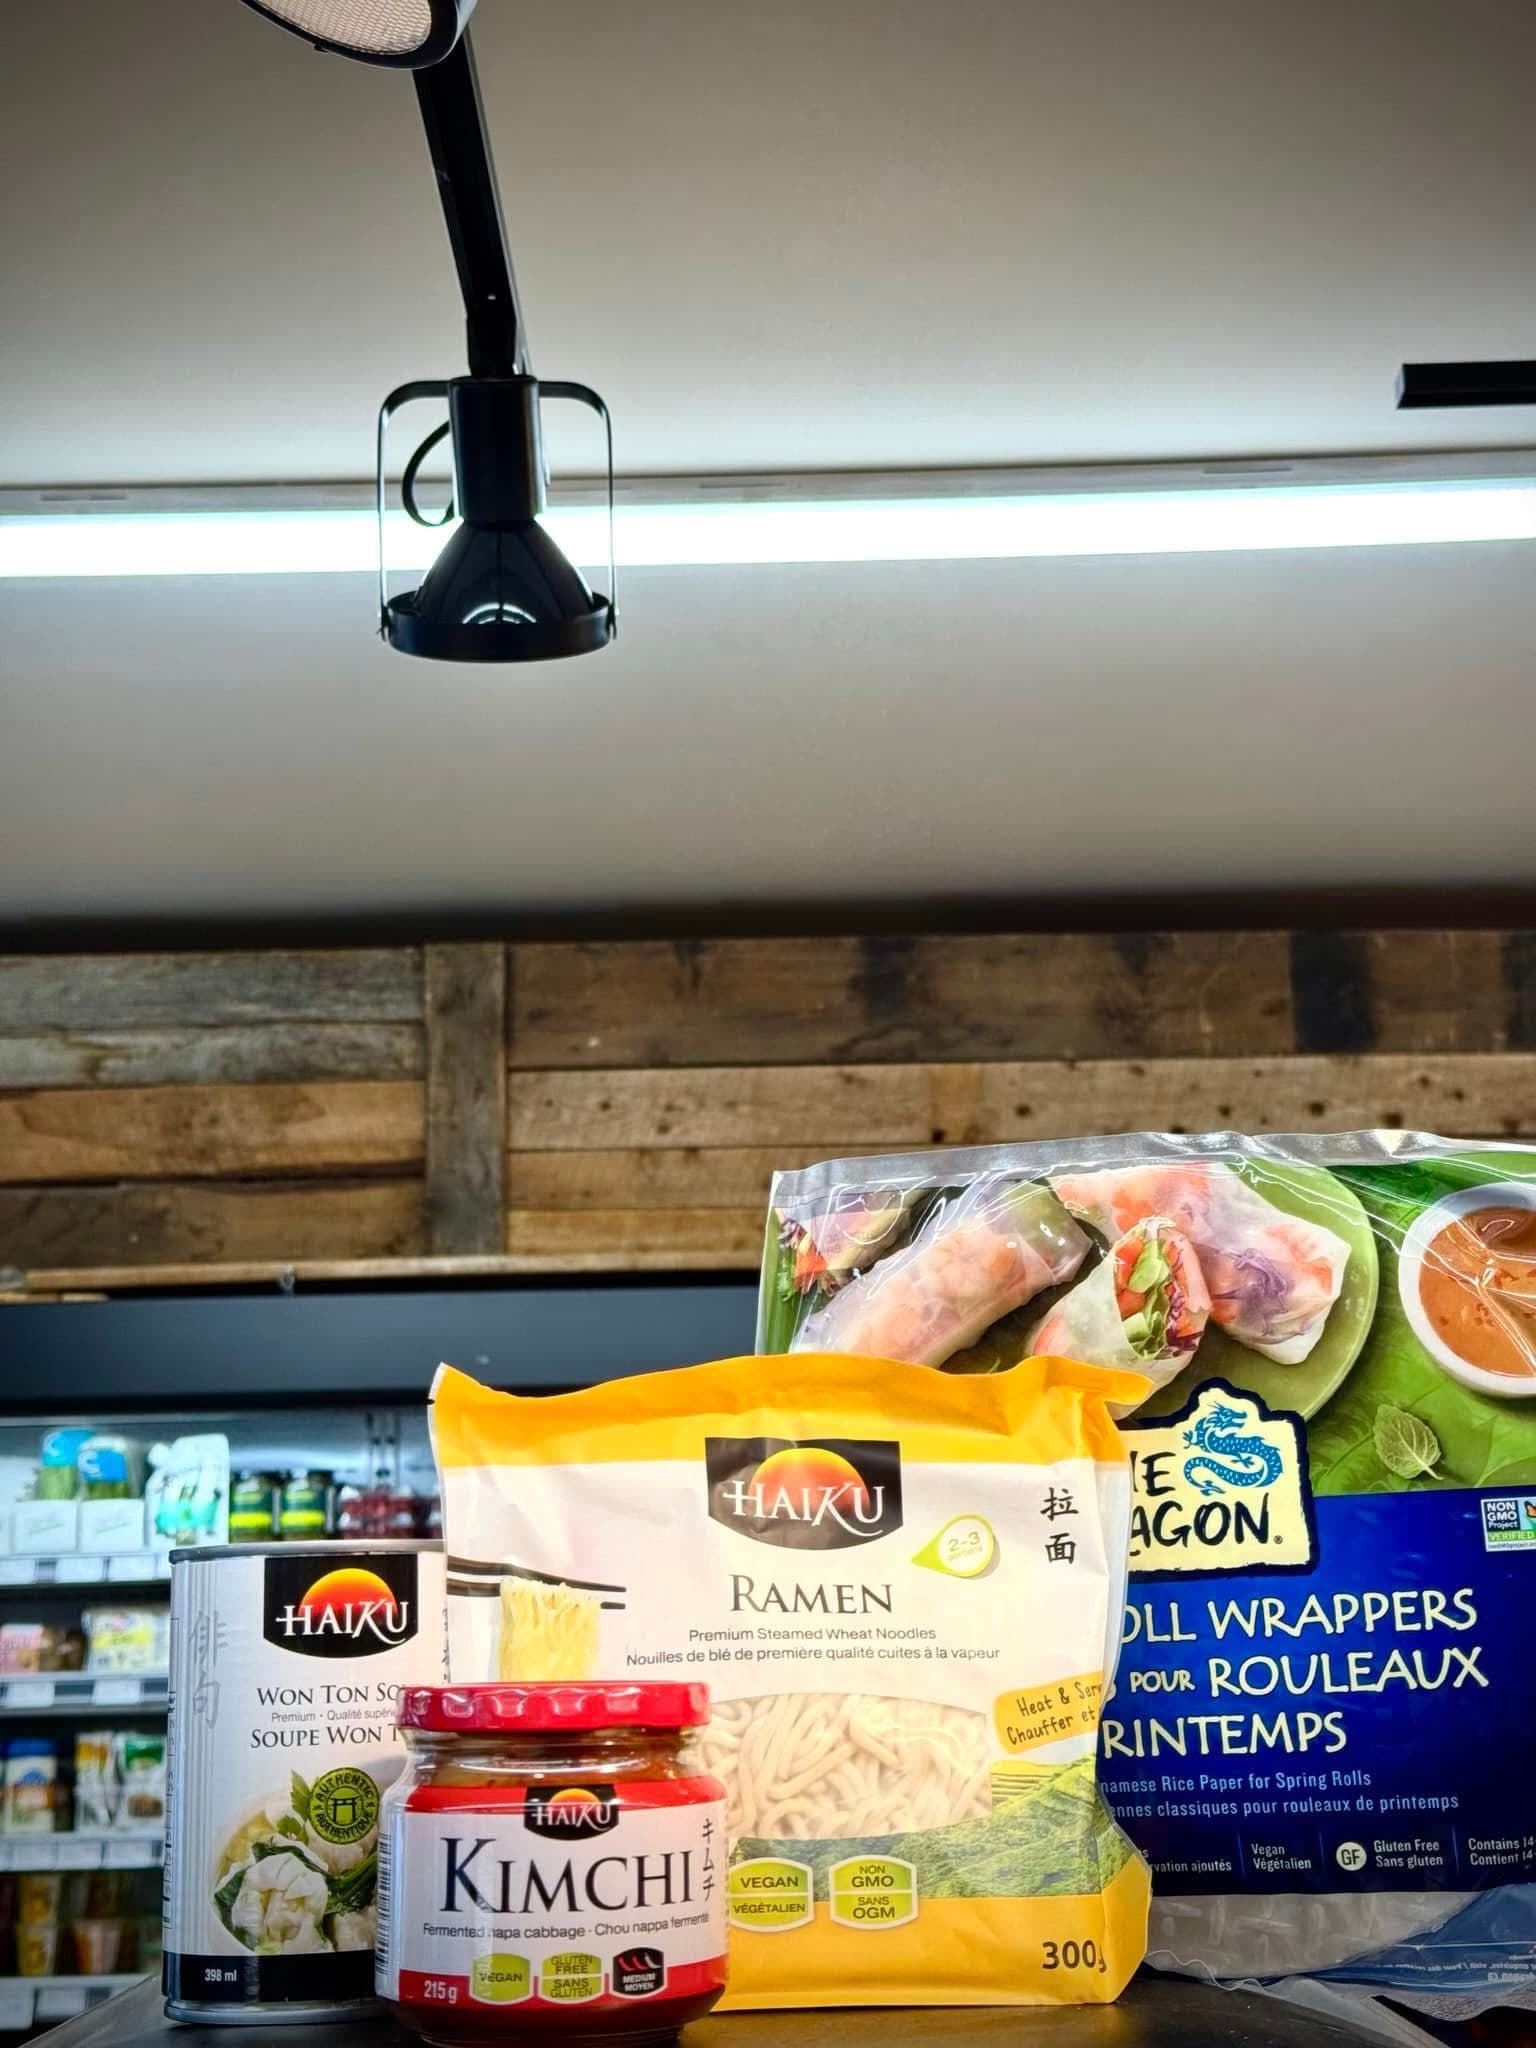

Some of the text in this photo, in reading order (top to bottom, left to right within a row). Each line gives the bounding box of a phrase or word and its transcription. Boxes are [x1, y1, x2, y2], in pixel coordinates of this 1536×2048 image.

[722, 1479, 886, 1537] HAIKU
[1487, 1501, 1516, 1511] NON
[1130, 1492, 1270, 1550] AGON
[1487, 1511, 1517, 1521] GMO
[1040, 1487, 1079, 1564] 拉面
[1488, 1521, 1518, 1530] Project
[948, 1531, 980, 1552] 2-3
[1488, 1531, 1535, 1540] VERIFIED
[730, 1574, 893, 1613] RAMEN
[276, 1599, 409, 1645] HAIKU
[1207, 1588, 1478, 1640] WRAPPERS
[689, 1627, 937, 1641] Premium Steamed Wheat Noodles
[626, 1646, 1001, 1666] Nouilles de blé de première qualité cuites à la vapeur
[1130, 1646, 1489, 1698] POUR ROULEAUX
[257, 1682, 400, 1706] WON TON SO
[1016, 1681, 1102, 1717] Heat & Serv
[271, 1711, 316, 1723] Premium
[326, 1709, 362, 1721] Qualité
[1006, 1705, 1096, 1745] Chauffer et
[250, 1728, 320, 1749] SOUPE
[325, 1725, 382, 1745] WON
[1103, 1711, 1347, 1760] RINTEMPS
[1100, 1769, 1372, 1793] namese Rice Paper for Spring Rolls
[1111, 1794, 1459, 1818] ennes classiques pour rouleaux de printemps
[531, 1802, 613, 1832] HAIKU
[1251, 1843, 1286, 1858] Vegan
[1373, 1838, 1440, 1853] Gluten Free
[1468, 1835, 1536, 1851] Contains 14
[702, 1817, 715, 1902] キムチ
[1150, 1857, 1232, 1874] rvation ajoutés
[1253, 1857, 1312, 1872] Végétalien
[1340, 1849, 1361, 1866] GF
[1376, 1854, 1444, 1870] Sans gluten
[1470, 1849, 1536, 1866] Contient 14
[439, 1836, 694, 1914] KIMCHI
[859, 1865, 886, 1874] NON
[740, 1875, 799, 1889] VEGAN
[851, 1875, 894, 1888] GMO
[733, 1902, 806, 1915] VÉGÉTALIEN
[857, 1896, 890, 1906] SANS
[852, 1907, 895, 1919] OGM
[423, 1922, 485, 1939] Fermented
[524, 1926, 586, 1941] cabbage
[595, 1923, 630, 1937] Chou
[633, 1920, 669, 1934] nappa
[550, 1955, 593, 1966] GLUTEN
[205, 1968, 237, 1982] 398 ml
[479, 1972, 523, 1982] VEGAN
[555, 1966, 588, 1975] FREE
[623, 1973, 656, 1984] MEDIUM
[554, 1978, 590, 1988] SANS
[424, 1979, 458, 2004] 215 g
[550, 1988, 593, 1998] GLUTEN
